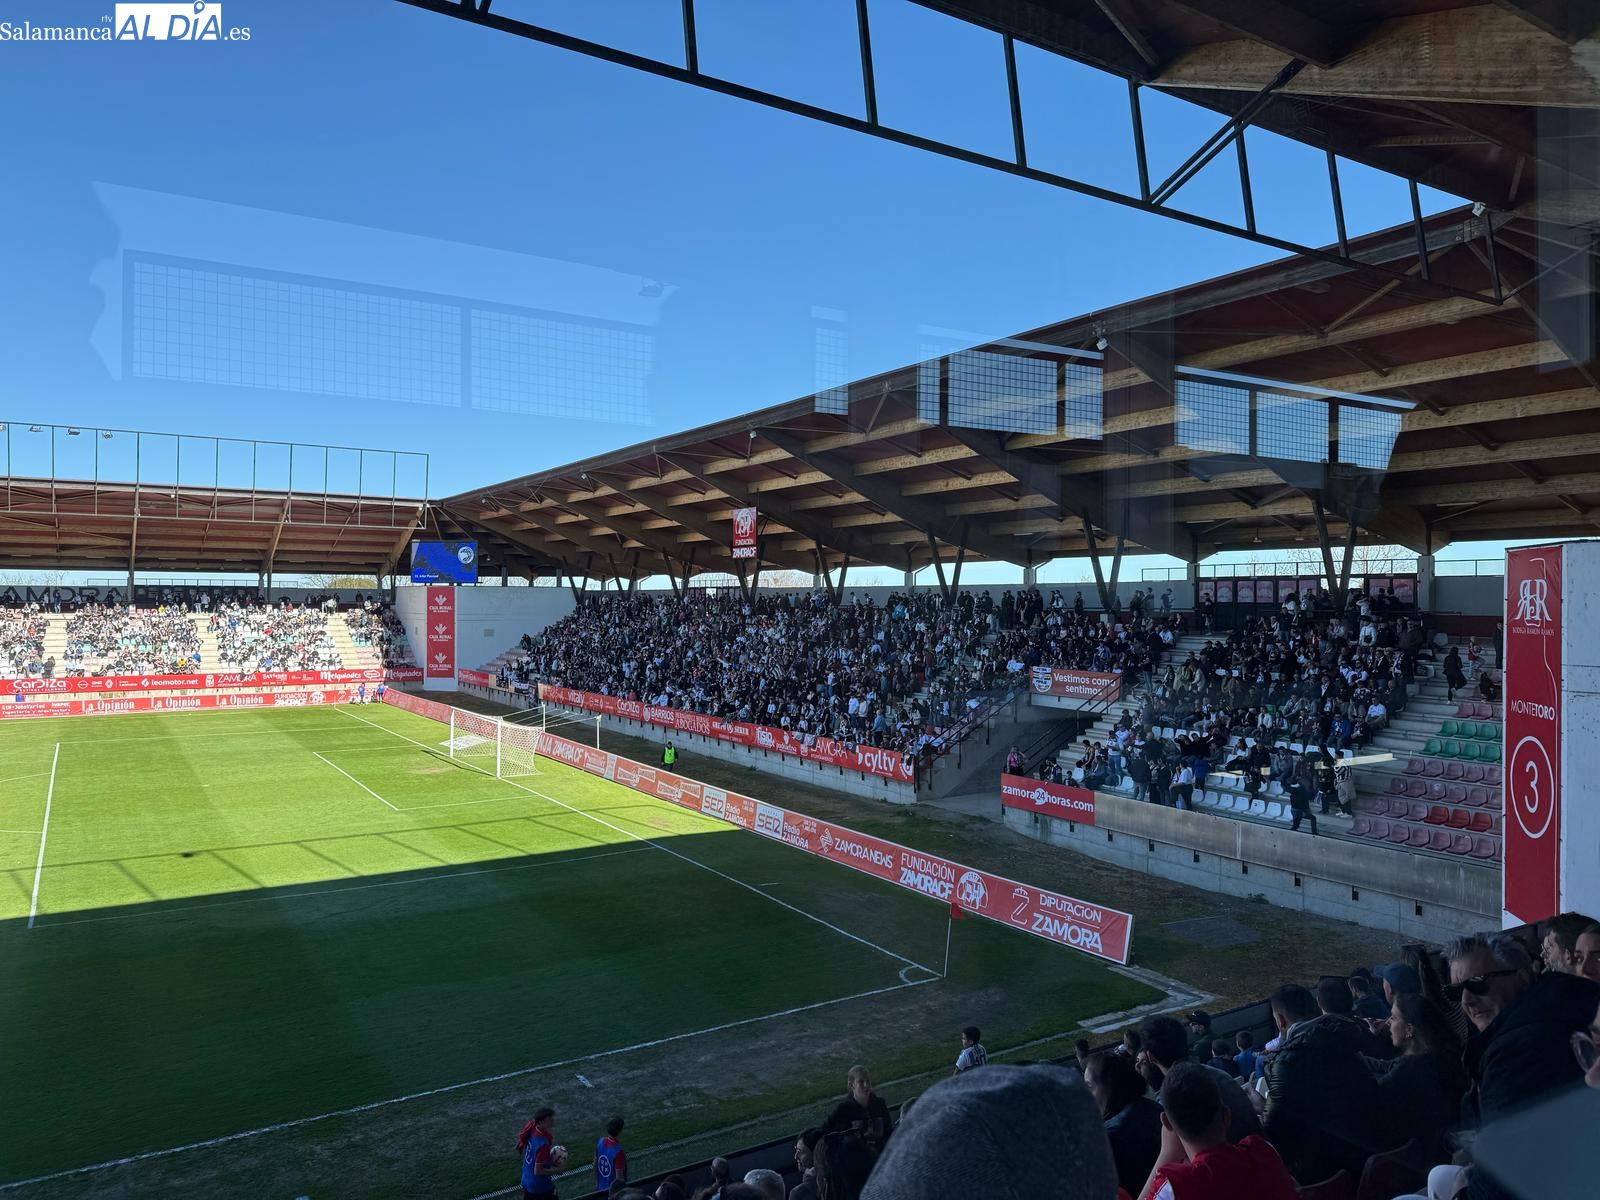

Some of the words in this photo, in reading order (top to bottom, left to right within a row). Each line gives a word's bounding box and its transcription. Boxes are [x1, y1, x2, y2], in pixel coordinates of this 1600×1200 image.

[320, 671, 362, 682] Melquiades
[384, 668, 423, 680] Melquiades
[1053, 673, 1090, 685] Vestimos
[1091, 678, 1116, 687] como
[1065, 685, 1102, 695] sentimos
[82, 700, 94, 712] La
[97, 699, 135, 714] Opinión
[151, 697, 162, 708] La
[165, 696, 201, 711] Opinión
[216, 694, 227, 705] La
[230, 693, 264, 708] Opinión
[650, 707, 675, 722] BARRIOS
[1511, 700, 1555, 720] MONTETORO
[674, 718, 711, 735] ABOGADOS
[864, 749, 896, 773] cyltv
[1524, 760, 1539, 814] 3
[726, 803, 741, 815] Radio
[724, 811, 747, 827] ZAMORA
[783, 822, 801, 836] Radio
[782, 831, 809, 849] ZAMORA
[901, 852, 955, 883] FUNDACIÓN
[1031, 912, 1103, 952] ZAMORA
